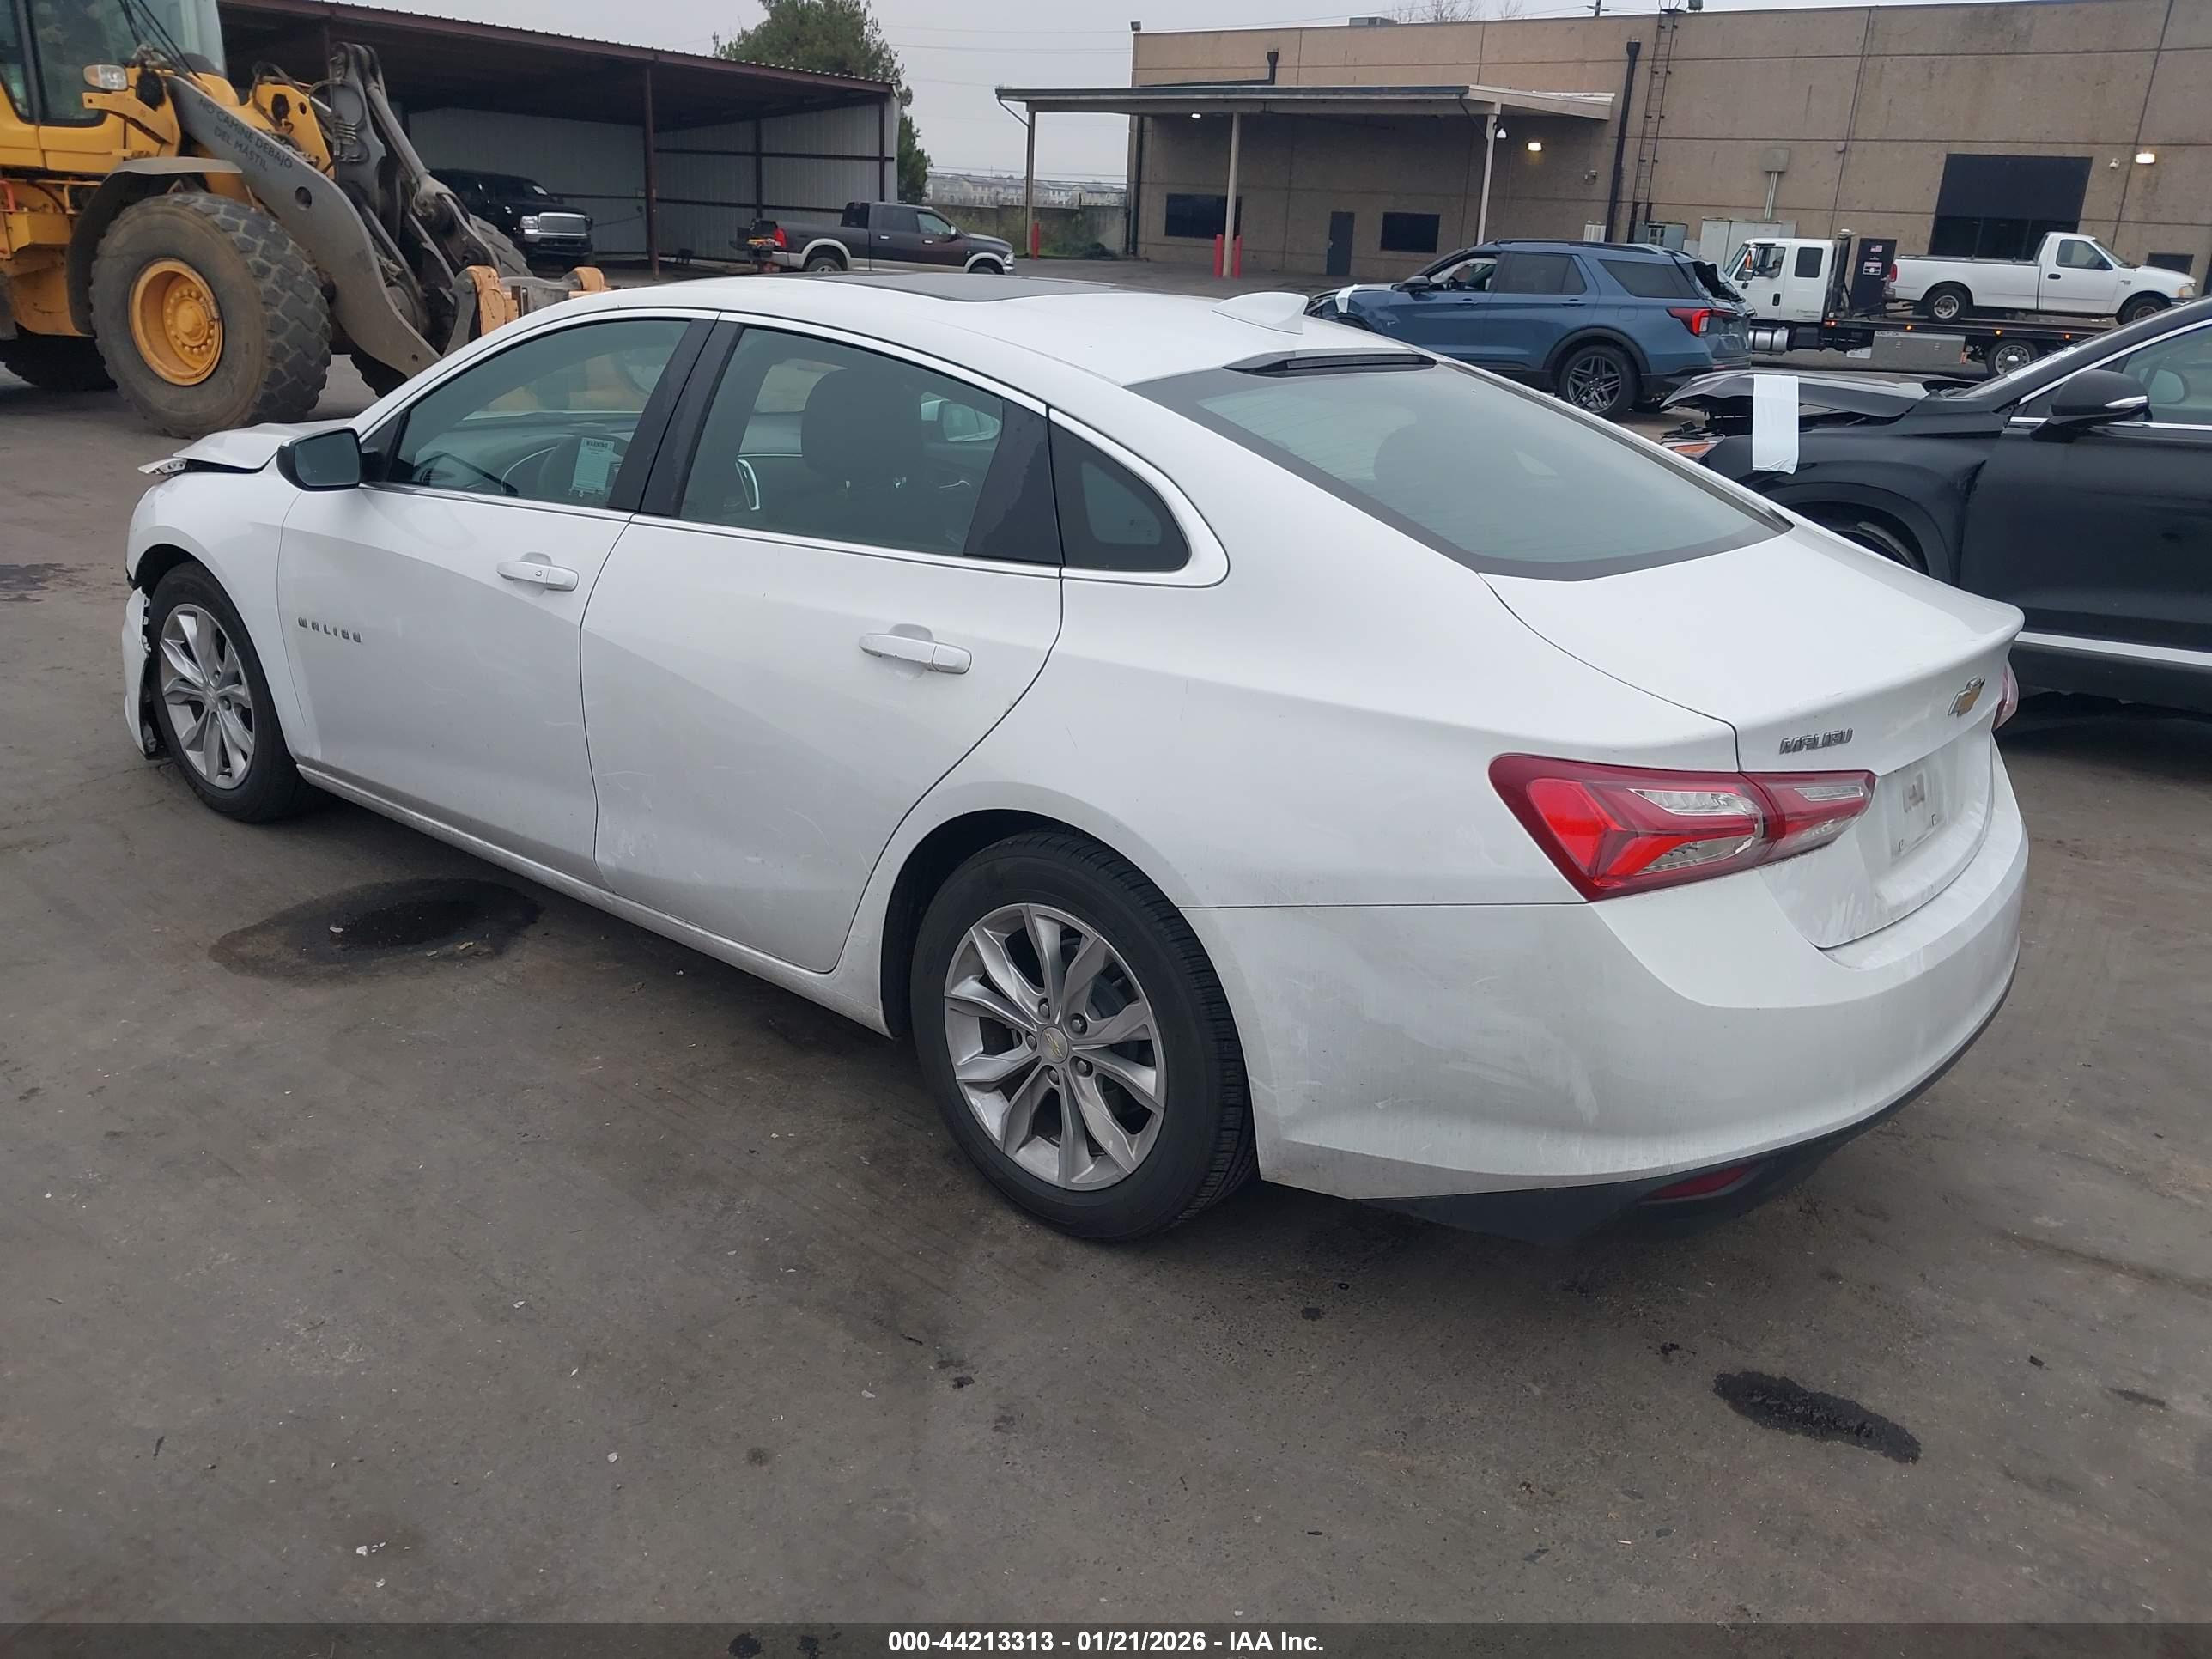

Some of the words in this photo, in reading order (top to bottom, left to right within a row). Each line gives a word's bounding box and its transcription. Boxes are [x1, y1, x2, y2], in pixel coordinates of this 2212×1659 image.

[214, 125, 232, 145] DEL
[297, 617, 362, 643] MALIBU
[1779, 728, 1853, 755] MALIBU
